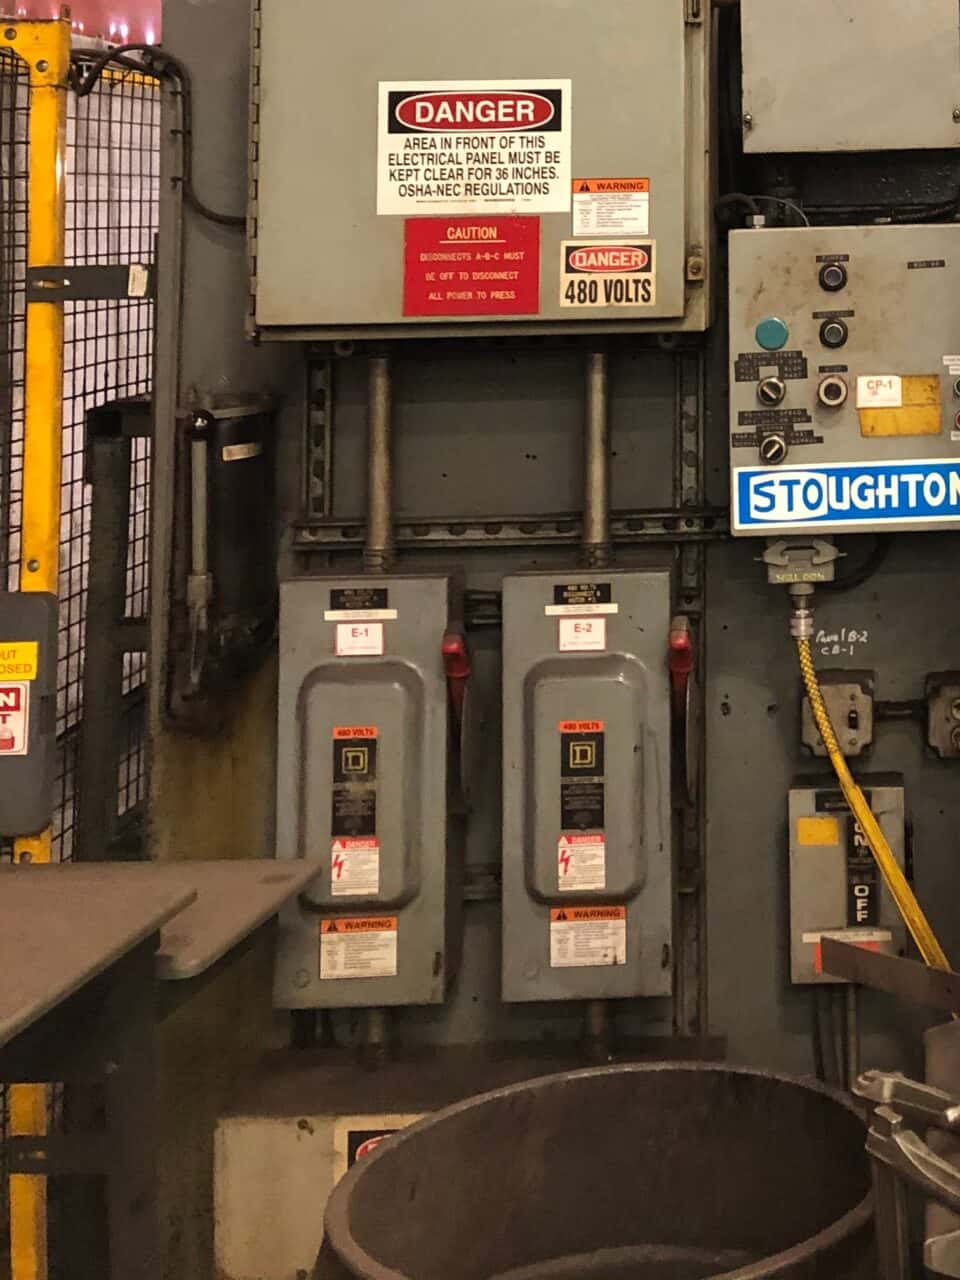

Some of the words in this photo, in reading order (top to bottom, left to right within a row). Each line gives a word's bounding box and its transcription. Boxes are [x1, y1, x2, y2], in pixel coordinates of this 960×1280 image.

[415, 100, 535, 123] DANGER
[403, 137, 437, 150] AREA
[440, 137, 452, 150] IN
[455, 136, 496, 149] FRONT
[499, 136, 516, 149] OF
[519, 135, 546, 149] THIS
[388, 152, 463, 166] ELECTRICAL
[465, 152, 505, 165] PANEL
[508, 151, 542, 164] MUST
[545, 151, 561, 164] BE
[389, 168, 421, 182] KEPT
[423, 167, 464, 181] CLEAR
[467, 167, 492, 180] FOR
[495, 167, 509, 180] 36
[511, 166, 560, 180] INCHES.
[398, 183, 461, 197] OSHA-NEC
[464, 182, 550, 196] REGULATIONS
[596, 182, 644, 191] WARNING
[446, 226, 497, 240] CAUTION
[575, 251, 643, 267] DANGER
[564, 279, 598, 304] 480
[604, 278, 652, 303] VOLTS
[866, 380, 893, 390] CP-1
[351, 627, 369, 638] E-1
[573, 623, 593, 633] E-2
[0, 650, 17, 660] UT
[853, 884, 870, 923] OFF
[574, 908, 621, 919] WARNING
[345, 919, 393, 930] WARNING
